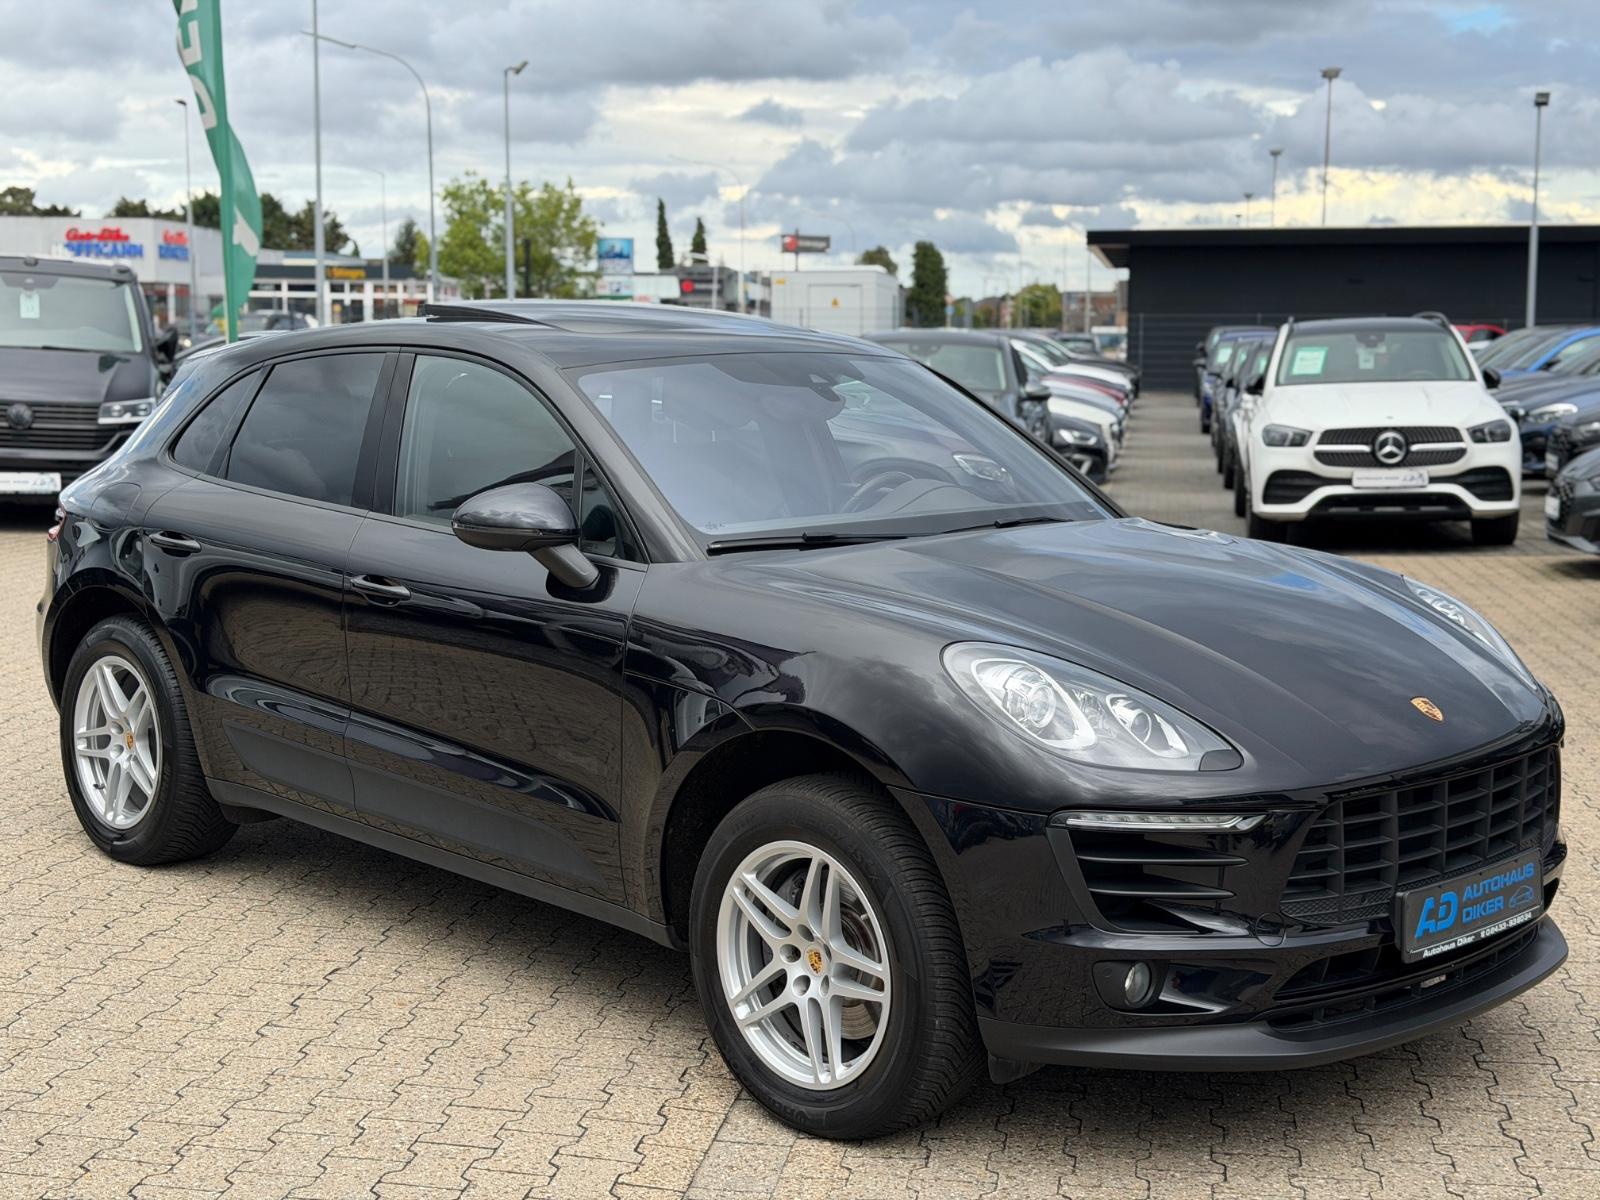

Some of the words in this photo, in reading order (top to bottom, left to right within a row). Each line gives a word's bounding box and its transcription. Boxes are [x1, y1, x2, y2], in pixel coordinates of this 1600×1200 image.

[1462, 863, 1535, 900] AUTOHAUS
[1462, 896, 1505, 923] DIKER
[1422, 943, 1456, 958] Autohaus
[1457, 935, 1475, 947] Diker
